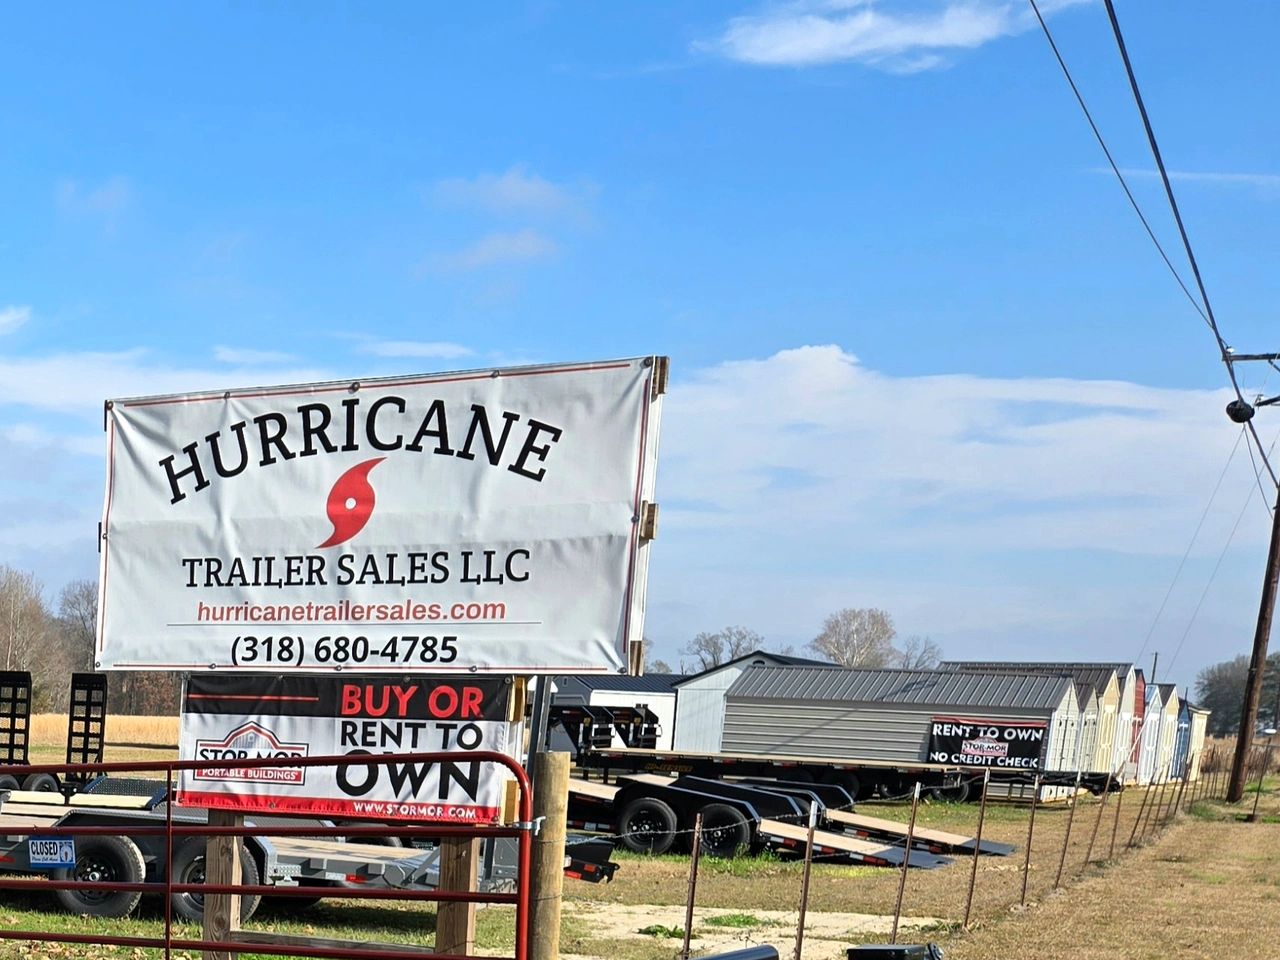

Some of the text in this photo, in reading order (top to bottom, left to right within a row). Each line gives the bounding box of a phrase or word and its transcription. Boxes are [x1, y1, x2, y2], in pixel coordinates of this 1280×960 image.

[158, 395, 563, 505] HURRICANE
[182, 549, 530, 588] TRAILER SALES LLC
[197, 600, 506, 622] hurricanetrailersales.com
[230, 635, 458, 667] (318) 680-4785
[341, 684, 484, 718] BUY OR
[341, 720, 483, 750] RENT TO
[932, 724, 1043, 741] RENT TO OWN
[929, 752, 1038, 768] NO CREDIT CHECK
[202, 768, 298, 780] PORTABLE BUILDINGS
[336, 749, 481, 803] OWN
[353, 802, 476, 819] WWW.STORMOR.COM
[31, 842, 58, 855] CLOSED
